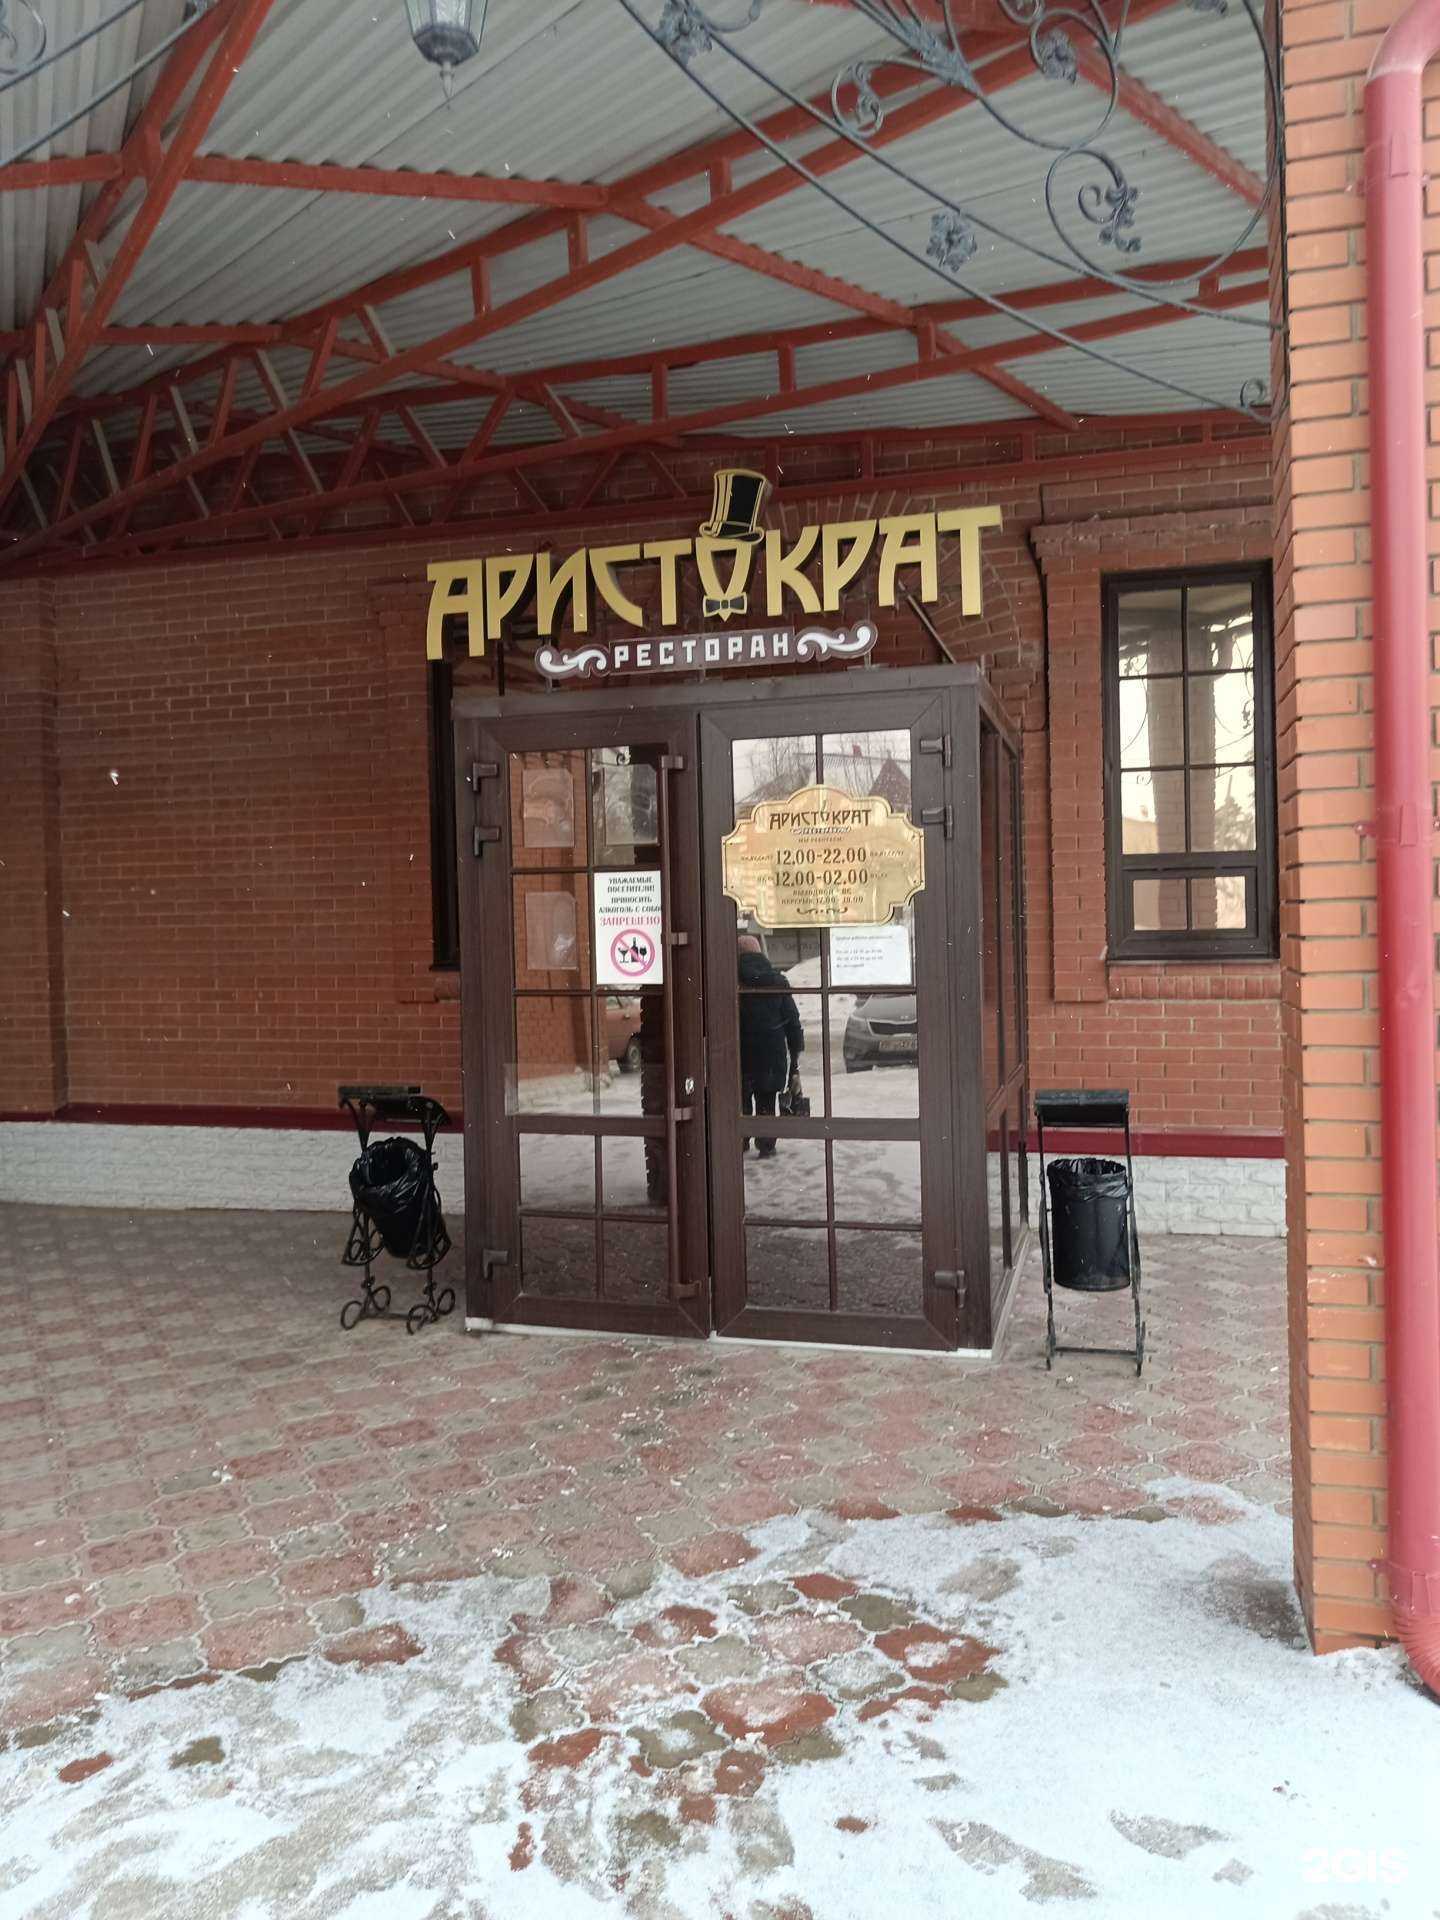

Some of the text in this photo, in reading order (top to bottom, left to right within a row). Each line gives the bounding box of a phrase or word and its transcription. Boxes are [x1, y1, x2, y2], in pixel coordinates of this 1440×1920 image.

[426, 505, 1002, 660] АРИСТОКРАТ
[614, 632, 789, 669] РЕСТОРАН
[769, 808, 872, 830] АРИСТОКРАТ
[609, 876, 652, 884] УВАЖАЕМЫЕ
[607, 884, 655, 893] ПОСЕТИТЕЛИ!
[611, 896, 653, 904] ПРИНОСИТЬ
[600, 916, 661, 926] ЗАПРЕЩЕНО
